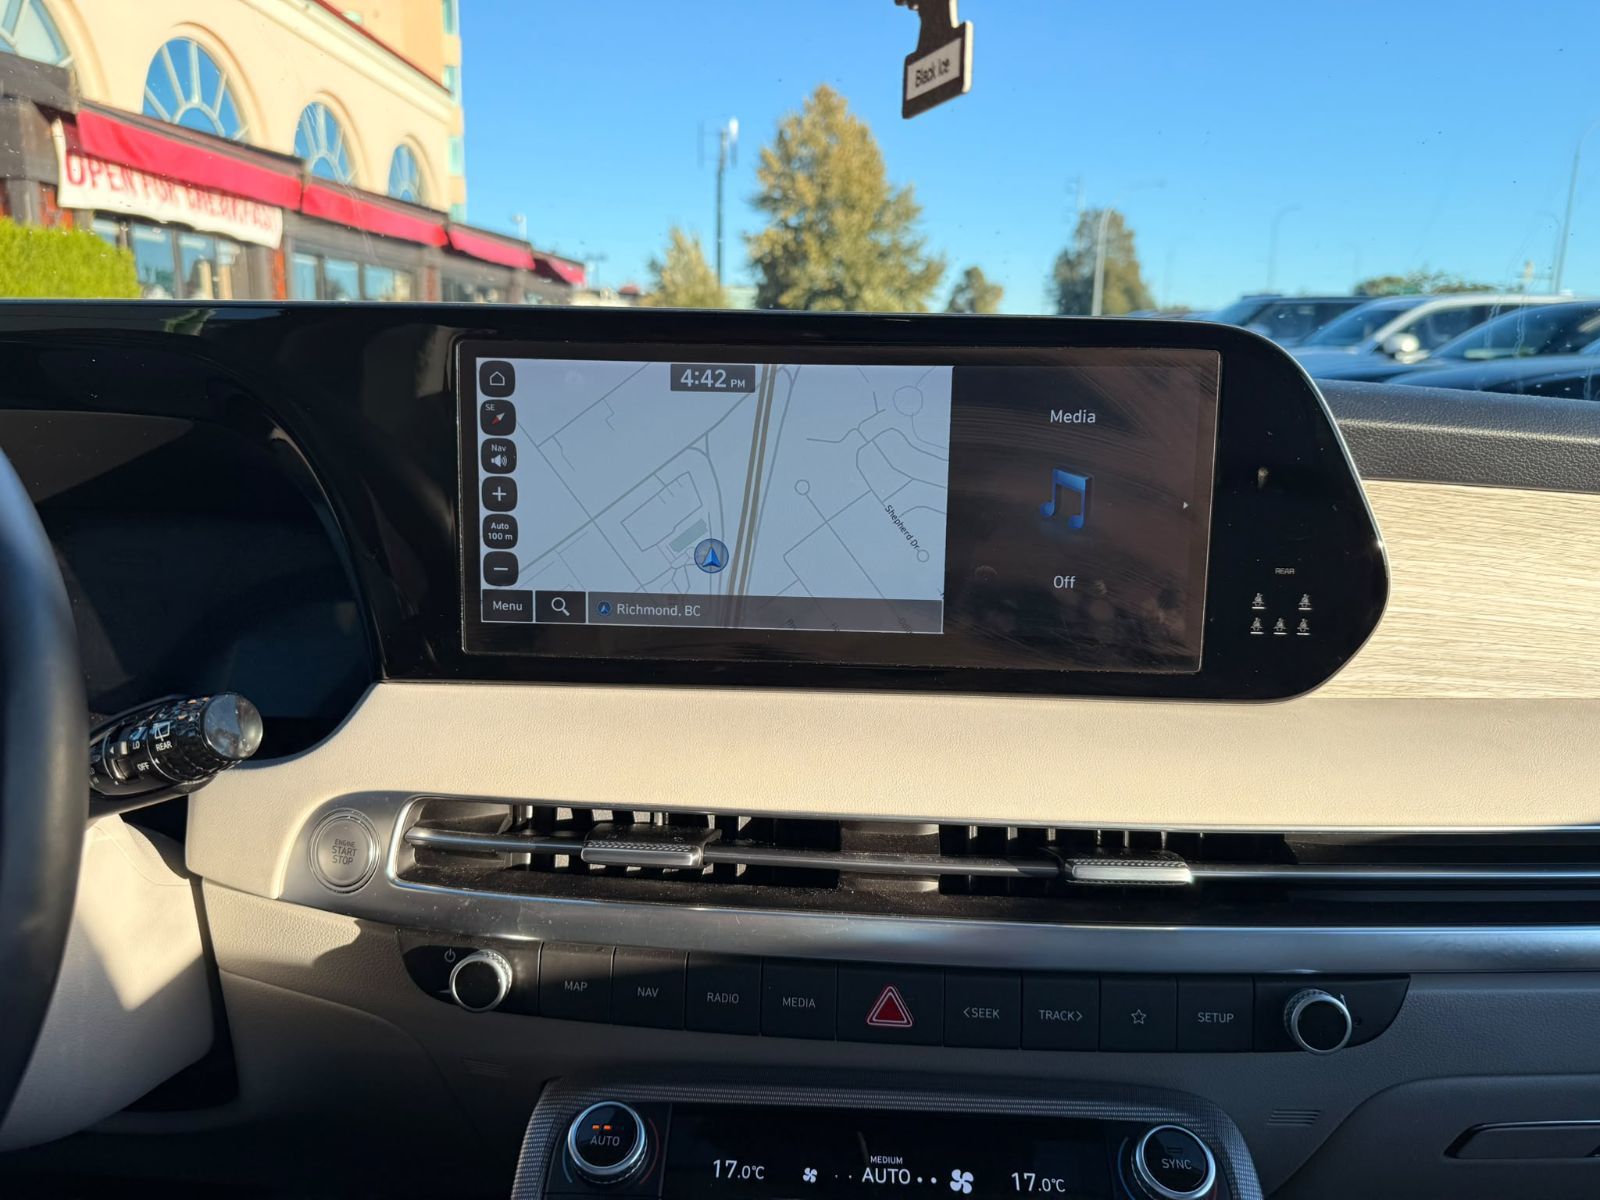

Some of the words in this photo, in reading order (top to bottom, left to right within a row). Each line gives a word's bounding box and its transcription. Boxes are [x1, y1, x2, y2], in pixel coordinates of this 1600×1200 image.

[915, 61, 936, 87] Black
[938, 58, 950, 77] Ice
[65, 154, 137, 197] OPEN
[680, 368, 727, 388] 4:42
[730, 379, 746, 388] PM
[485, 403, 495, 411] SE
[1050, 409, 1096, 423] Media
[491, 444, 506, 452] Nav
[490, 522, 510, 530] Auto
[884, 504, 913, 541] Shepherd
[909, 539, 920, 550] Dr
[487, 532, 503, 540] 100
[1274, 567, 1295, 575] REAR
[1053, 575, 1076, 589] Off
[492, 601, 523, 611] Menu
[616, 603, 682, 617] Richmond,
[684, 605, 701, 616] BC
[132, 741, 140, 750] LO
[155, 741, 172, 751] REAR
[137, 762, 150, 771] OFF
[334, 838, 356, 847] ENGINE
[331, 845, 357, 857] START
[332, 854, 354, 865] STOP
[564, 980, 588, 992] MAP
[637, 986, 659, 998] NAV
[706, 992, 740, 1004] RADIO
[782, 996, 816, 1008] MEDIA
[1197, 1012, 1235, 1023] SETUP
[590, 1135, 620, 1147] AUTO
[870, 1155, 903, 1165] MEDIUM
[1161, 1158, 1192, 1170] SYNC
[861, 1167, 911, 1185] AUTO
